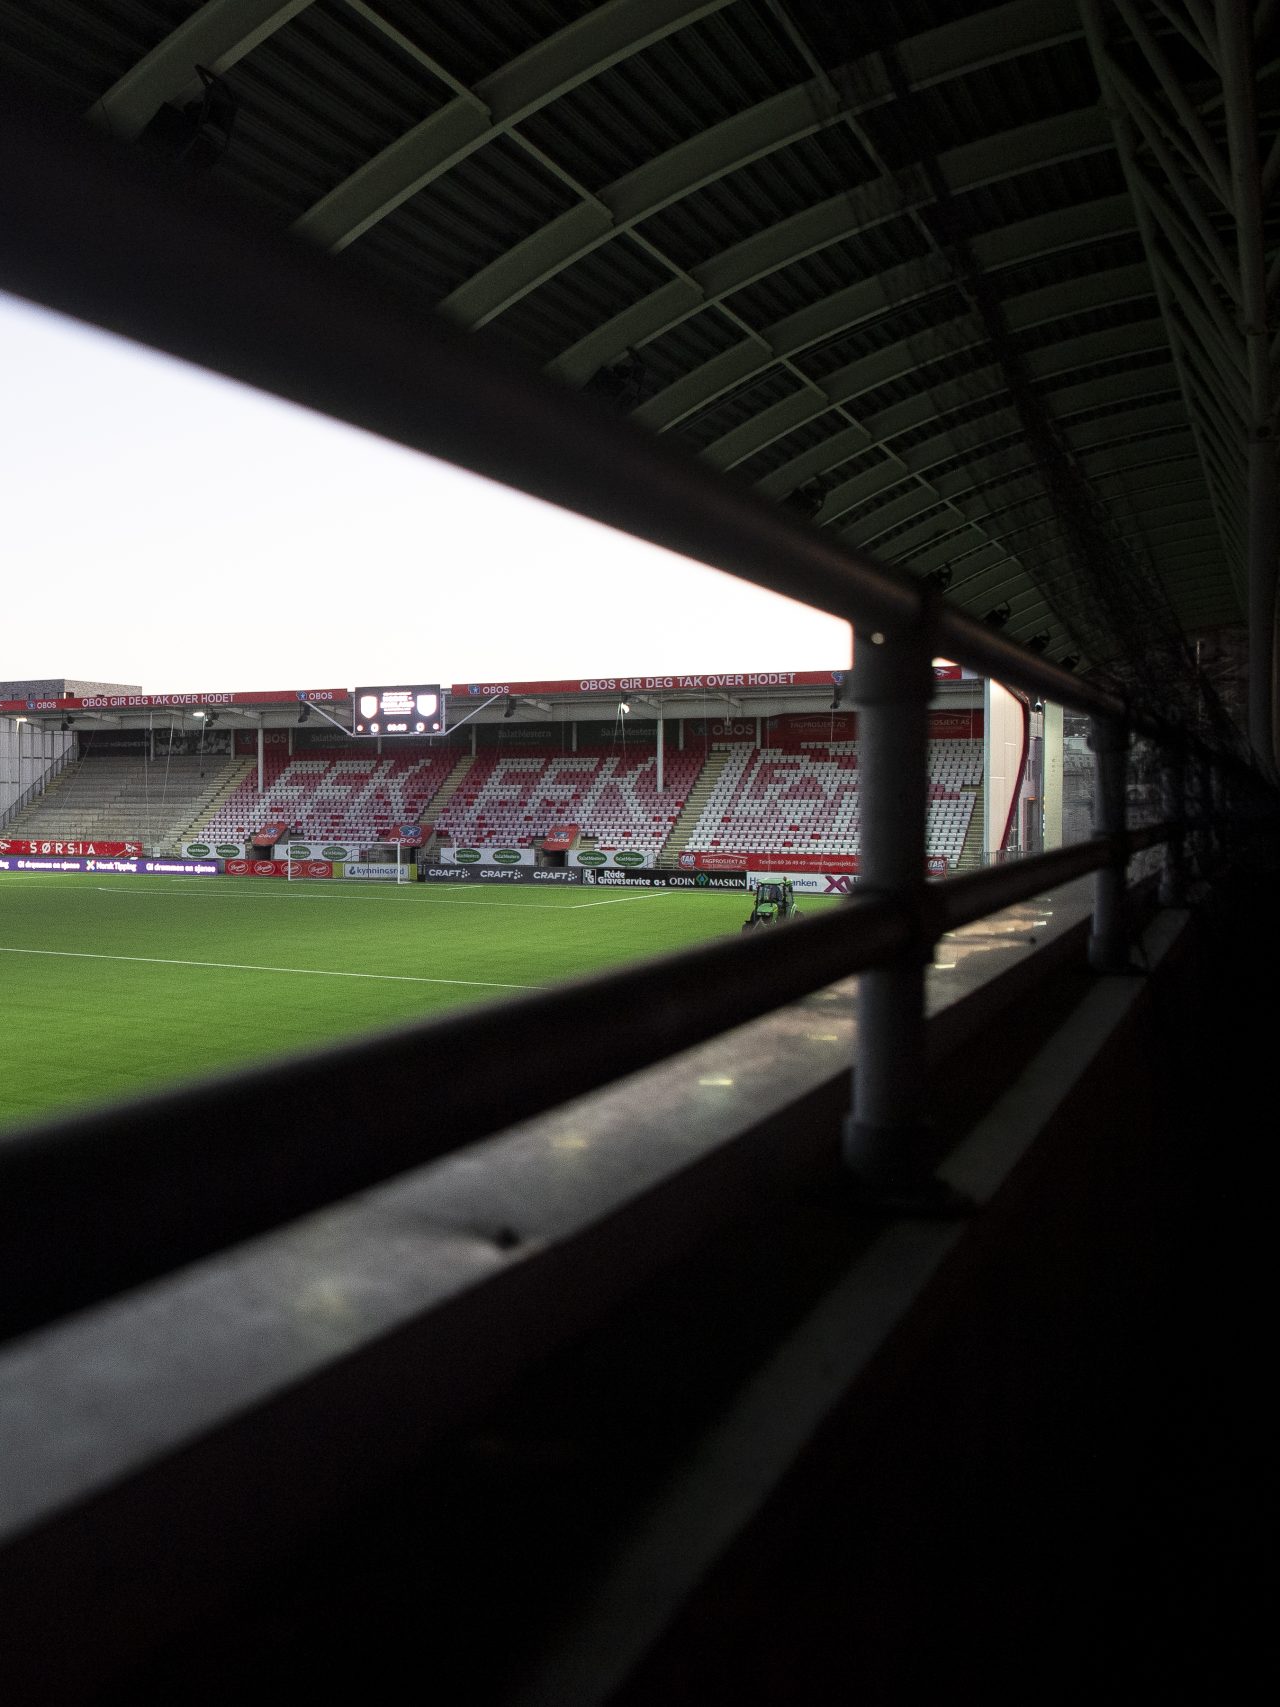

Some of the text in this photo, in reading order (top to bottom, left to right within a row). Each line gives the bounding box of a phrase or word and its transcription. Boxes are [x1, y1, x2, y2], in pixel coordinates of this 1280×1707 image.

[580, 672, 796, 691] OBOS GIR DEG TAK OVER HODET
[482, 685, 510, 695] OBOS
[82, 693, 236, 708] OBOS GIR DEG TAK OVER HODET
[309, 692, 332, 700] OBOS
[712, 724, 754, 736] OBOS
[30, 842, 96, 854] SØRSIA
[357, 866, 405, 876] kynningsrd
[428, 869, 461, 877] CRAFT
[480, 870, 513, 878] CRAFT
[533, 871, 567, 879] CRAFT
[597, 876, 651, 886] Graveservice
[669, 877, 695, 885] ODIN
[709, 878, 746, 887] MASKIN
